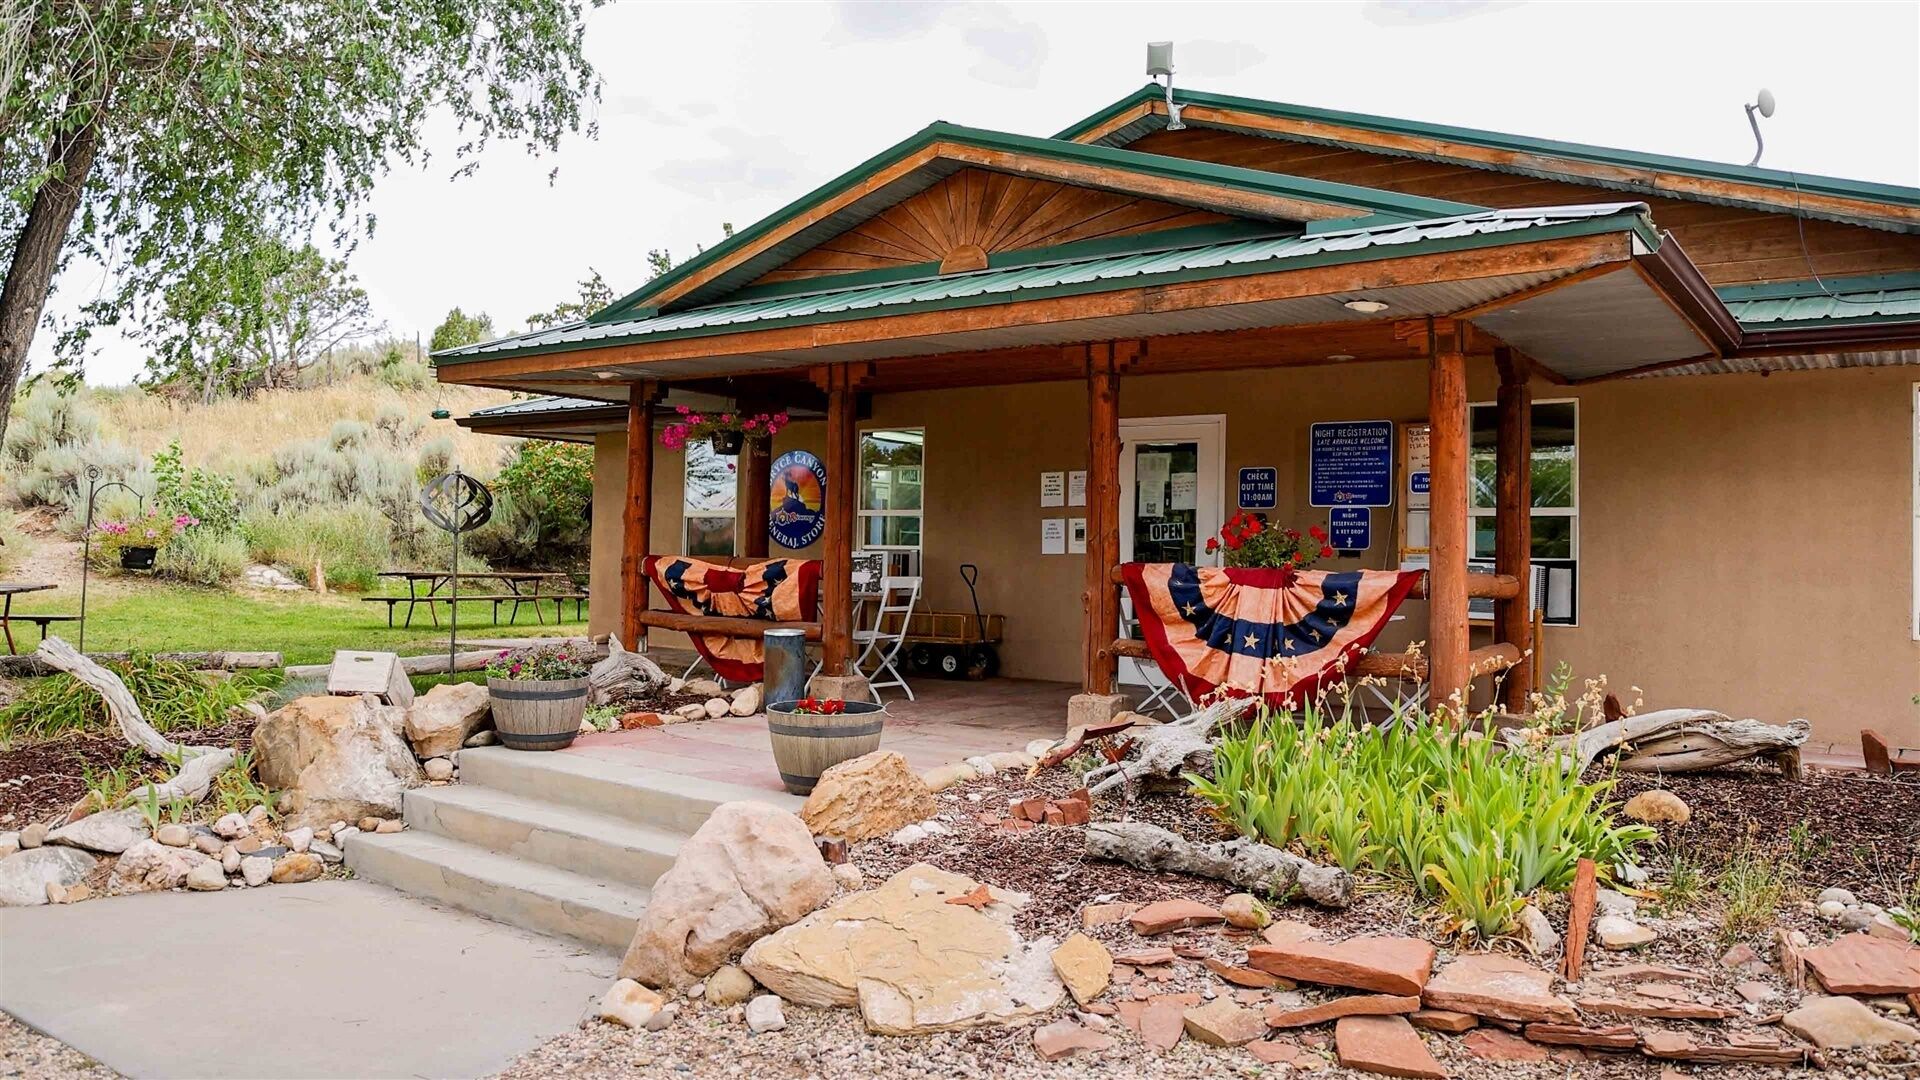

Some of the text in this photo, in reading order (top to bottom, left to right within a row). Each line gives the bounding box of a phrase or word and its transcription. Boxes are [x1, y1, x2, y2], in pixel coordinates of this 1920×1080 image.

[1315, 428, 1388, 438] NIGHT REGISTRATION
[795, 453, 827, 486] CANYON
[1241, 483, 1255, 491] OUT
[1243, 493, 1273, 501] 11:00AM
[801, 514, 826, 546] STORE
[1151, 524, 1183, 540] OPEN
